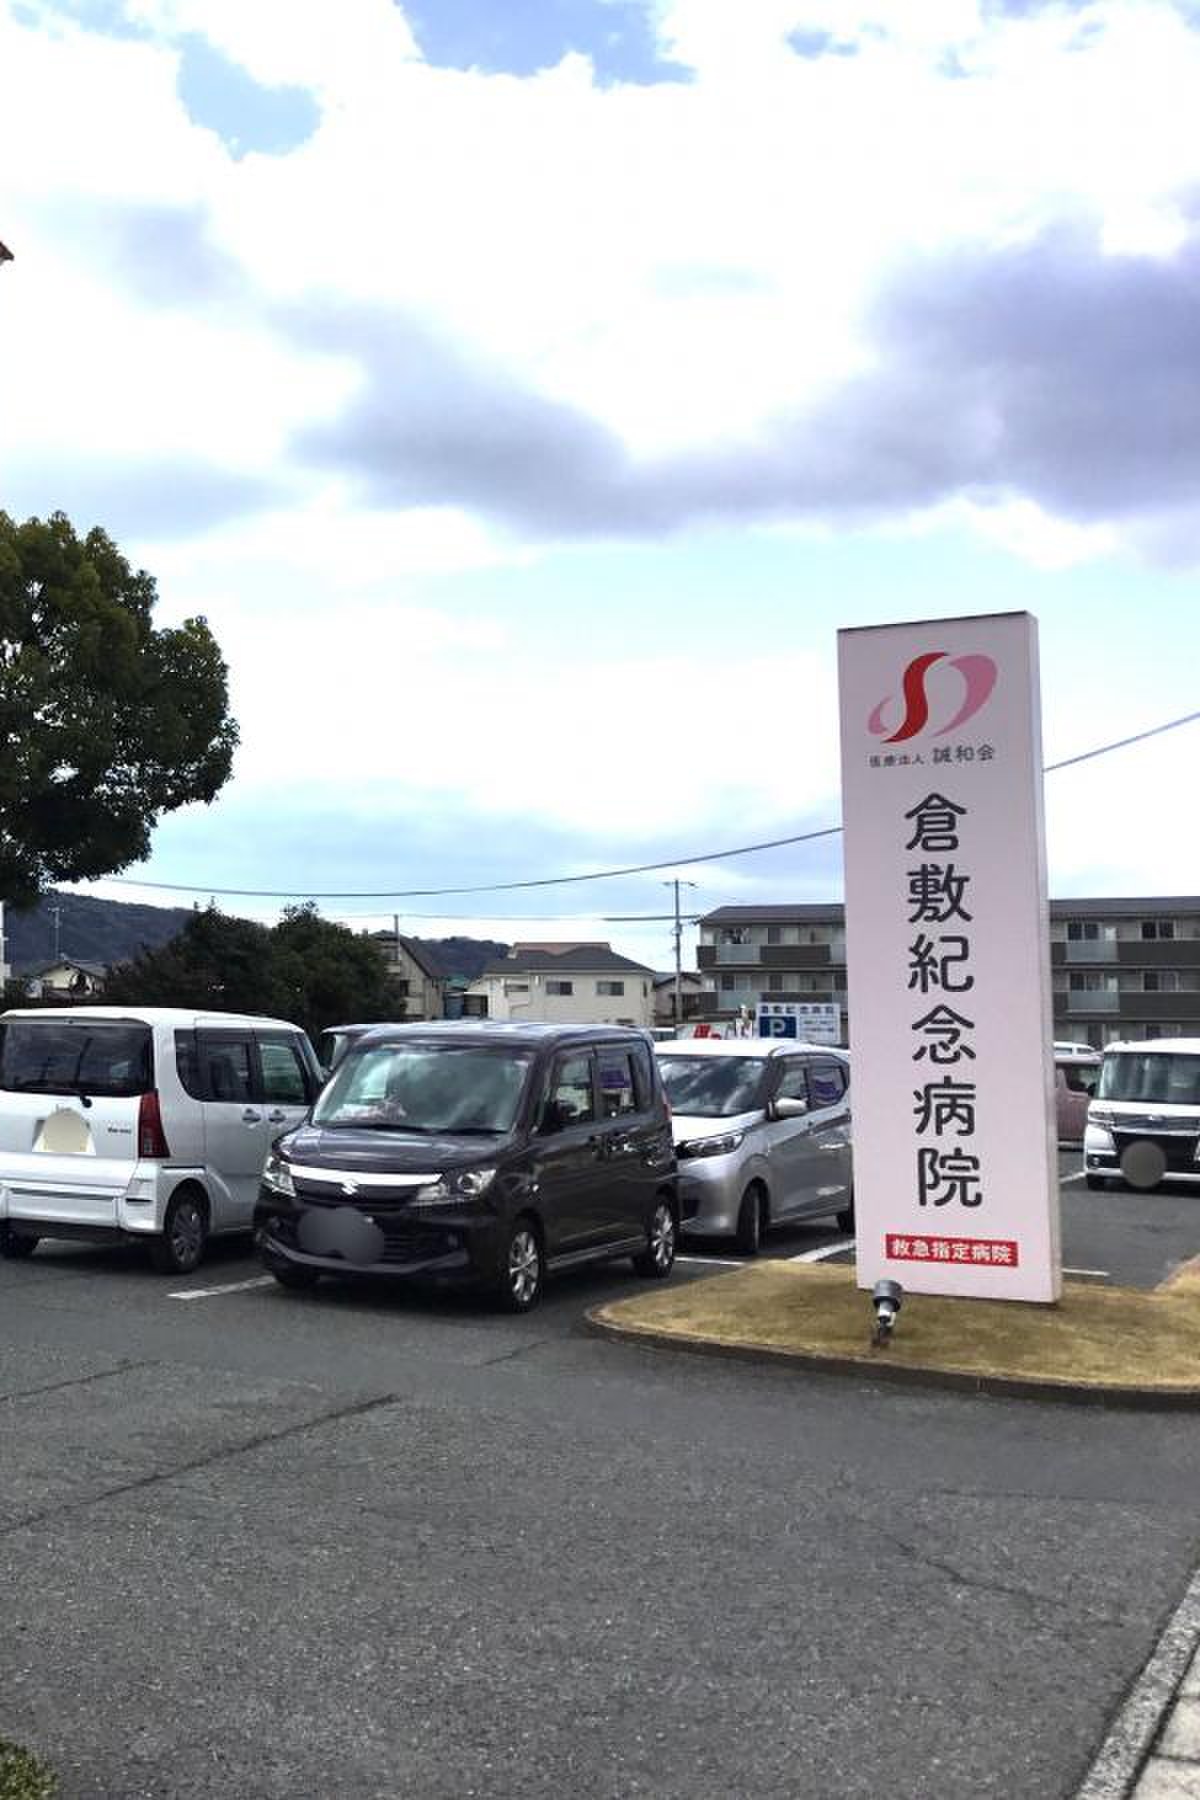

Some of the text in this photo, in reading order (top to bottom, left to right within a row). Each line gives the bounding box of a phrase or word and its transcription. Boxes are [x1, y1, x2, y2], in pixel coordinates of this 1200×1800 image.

[932, 744, 994, 764] 誠和会
[904, 792, 983, 1208] 倉敷紀念病院
[892, 1239, 1013, 1263] 救急指定病院
